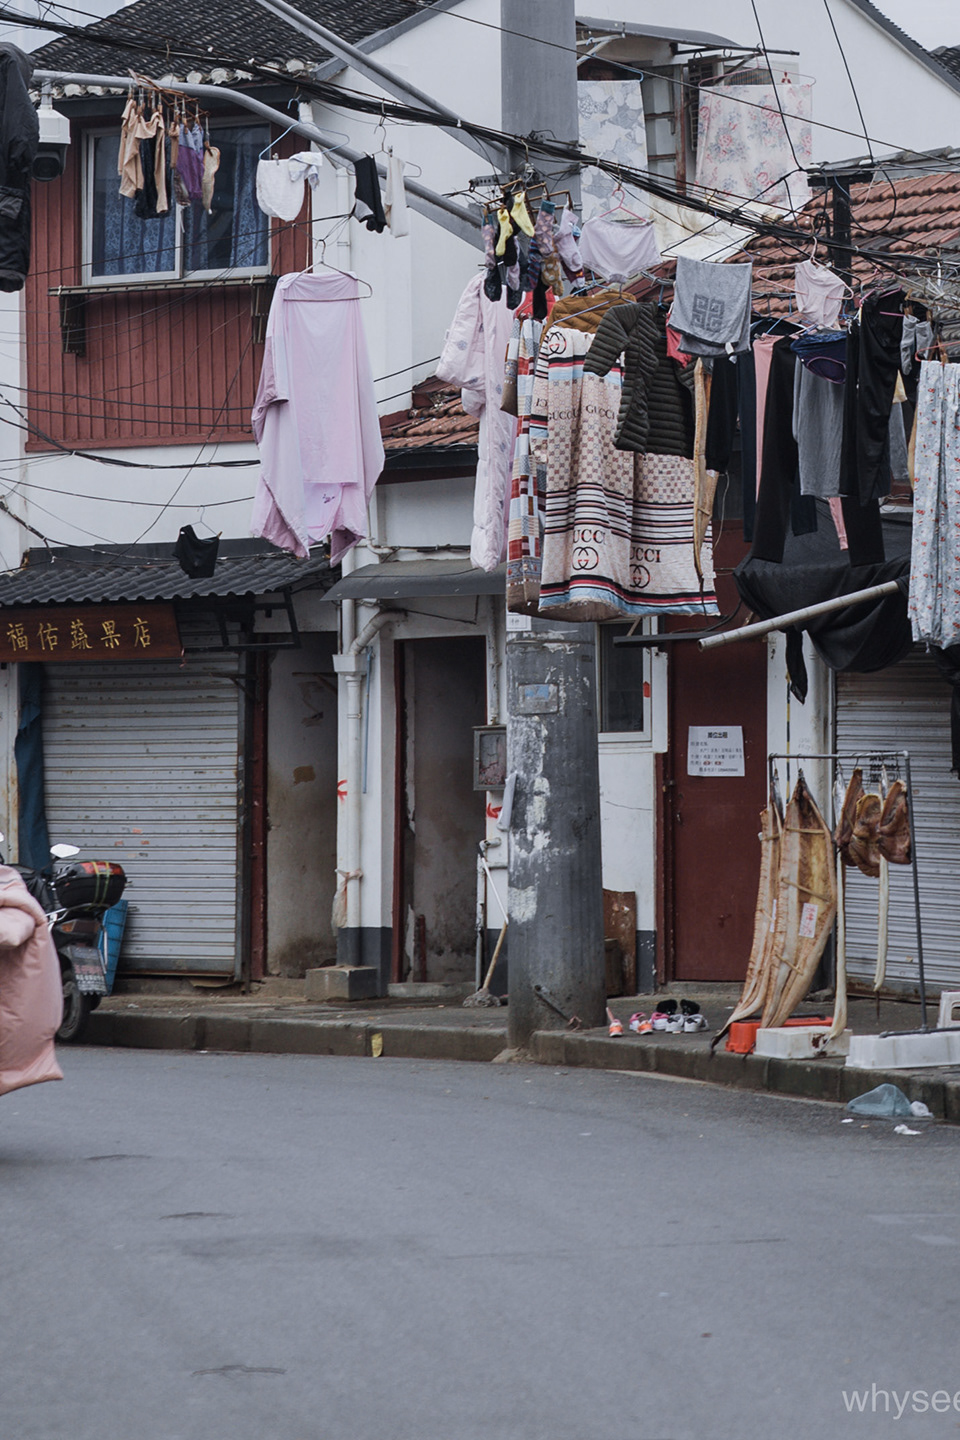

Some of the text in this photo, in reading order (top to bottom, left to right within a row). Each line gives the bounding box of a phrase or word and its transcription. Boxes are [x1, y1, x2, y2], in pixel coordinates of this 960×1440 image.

[6, 617, 151, 651] 福佑蔬果店
